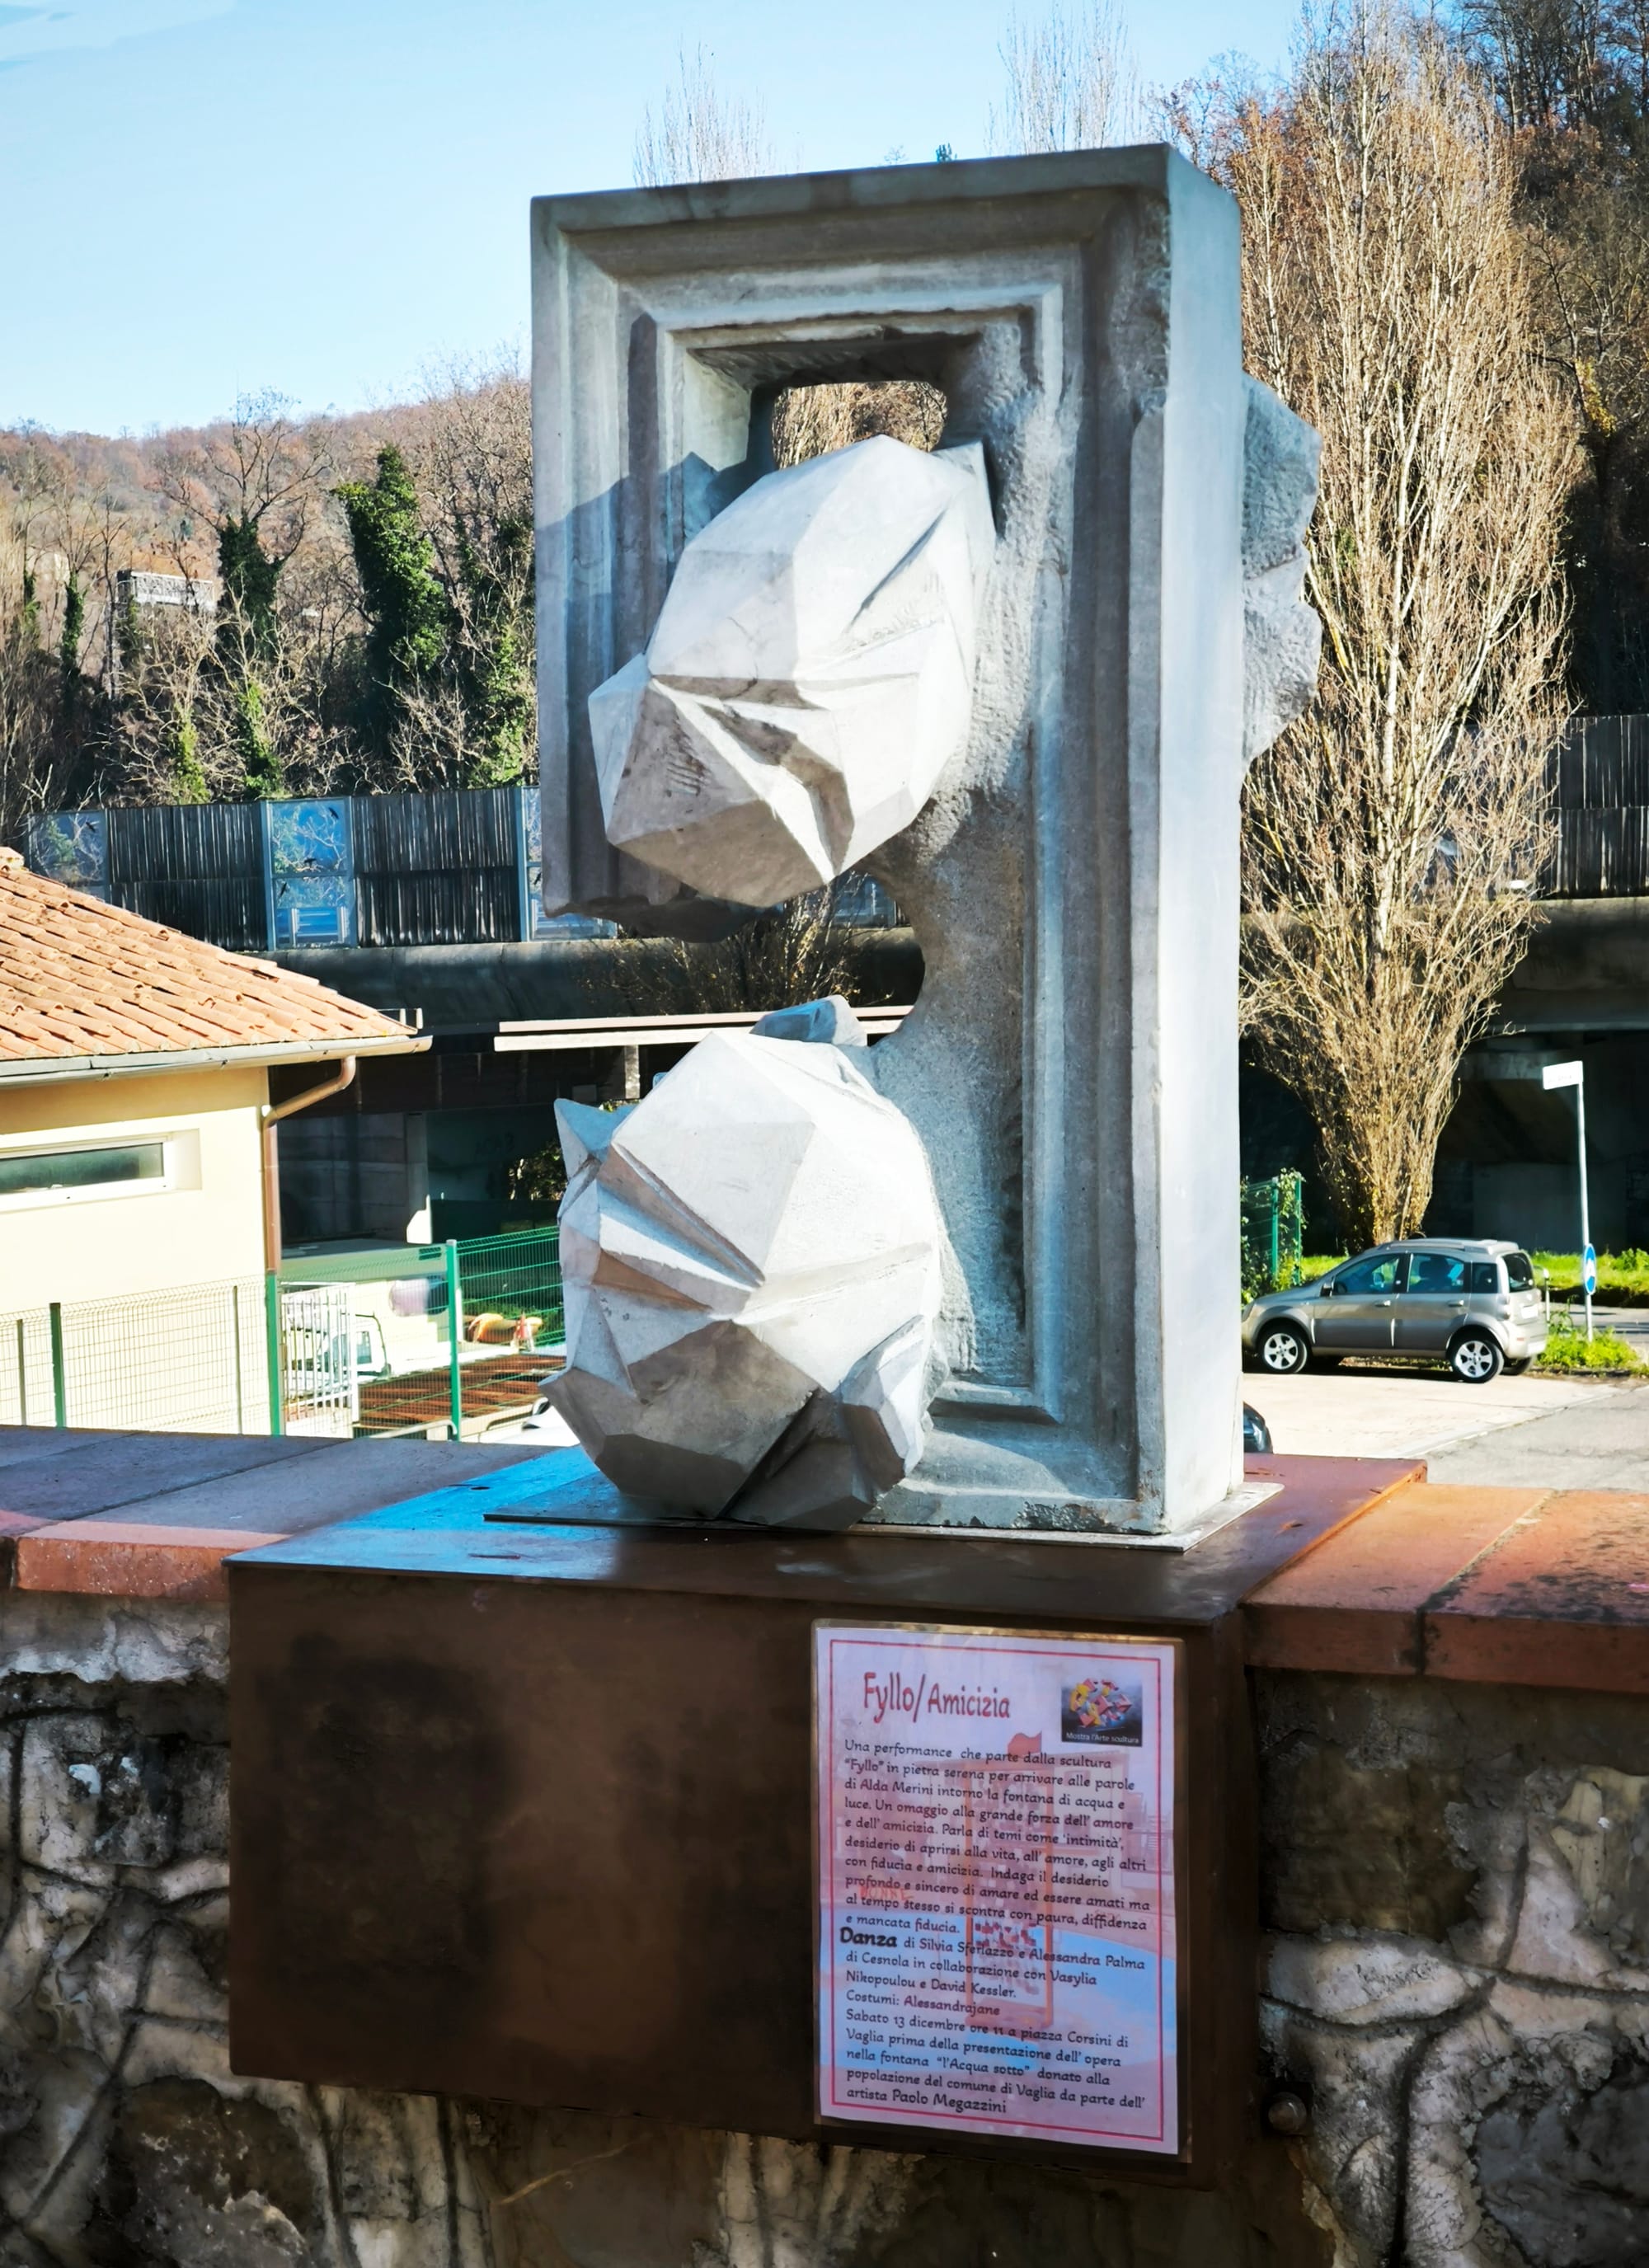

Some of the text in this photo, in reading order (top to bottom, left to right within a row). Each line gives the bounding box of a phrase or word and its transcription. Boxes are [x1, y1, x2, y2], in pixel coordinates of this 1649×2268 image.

[844, 1739, 1111, 1768] Una performance che parte dalla scultura
[886, 1761, 899, 1773] in
[902, 1763, 940, 1778] pietra
[944, 1768, 984, 1780] serena
[989, 1772, 1010, 1785] per
[1012, 1771, 1064, 1786] arrivare
[1067, 1773, 1091, 1787] alle
[1094, 1777, 1135, 1792] parole
[844, 1777, 1125, 1812] di Alda Merini intorno la fontana di acqua e
[844, 1796, 871, 1810] luce.
[875, 1798, 892, 1811] Un
[896, 1803, 948, 1819] omaggio
[951, 1804, 975, 1818] alla
[980, 1809, 1023, 1823] grande
[1027, 1810, 1060, 1826] forza
[1092, 1819, 1134, 1830] amore
[844, 1819, 852, 1827] e
[882, 1820, 938, 1834] amicizia.
[942, 1823, 973, 1838] Parla
[977, 1825, 989, 1838] di
[994, 1828, 1022, 1841] temi
[1025, 1834, 1059, 1844] come
[844, 1834, 900, 1850] desiderio
[904, 1839, 915, 1852] di
[919, 1843, 960, 1858] aprirsi
[964, 1845, 988, 1858] alla
[991, 1847, 1020, 1862] vita,
[1045, 1855, 1088, 1868] amore,
[1091, 1855, 1114, 1872] agli
[1119, 1857, 1147, 1871] altri
[844, 1856, 1109, 1888] con fiducia e amicizia. Indaga il desiderio
[845, 1874, 900, 1894] profondo
[904, 1882, 911, 1890] e
[914, 1880, 959, 1895] sincero
[962, 1883, 975, 1895] di
[979, 1889, 1019, 1899] amare
[1023, 1889, 1039, 1901] ed
[1043, 1894, 1082, 1905] essere
[1086, 1896, 1125, 1909] amati
[1128, 1901, 1150, 1911] ma
[845, 1892, 857, 1904] al
[861, 1896, 900, 1912] tempo
[904, 1897, 940, 1913] stesso
[945, 1901, 954, 1913] si
[959, 1906, 1005, 1918] scontra
[1009, 1910, 1033, 1920] con
[1036, 1913, 1078, 1928] paura,
[1081, 1912, 1147, 1930] diffidenza
[845, 1915, 960, 1933] e mancata fiducia.
[839, 1926, 898, 1948] Danza
[903, 1936, 915, 1949] di
[918, 1937, 953, 1952] Silvia
[1018, 1948, 1026, 1959] e
[1029, 1947, 1101, 1965] Alessandra
[1105, 1954, 1145, 1970] Palma
[845, 1950, 1097, 1988] di Cesnola in collaborazione con Vasylia
[846, 1969, 1016, 1998] Nikopoulou e David Kessler.
[846, 1989, 1000, 2017] Costumi: Alessandrajane
[846, 2007, 1128, 2048] Sabato 13 dicembre ore 11 a piazza Corsini di
[845, 2027, 884, 2045] Vaglia
[888, 2033, 925, 2048] prima
[928, 2036, 959, 2050] della
[962, 2043, 1051, 2060] presentazione
[1084, 2055, 1121, 2068] opera
[846, 2047, 876, 2061] nella
[880, 2050, 929, 2067] fontana
[1036, 2066, 1082, 2083] donato
[1085, 2072, 1110, 2086] alla
[846, 2068, 920, 2085] popolazione
[923, 2073, 942, 2087] del
[947, 2080, 996, 2092] comune
[999, 2082, 1012, 2094] di
[1015, 2083, 1055, 2102] Vaglia
[1059, 2087, 1076, 2101] da
[1080, 2094, 1115, 2107] parte
[846, 2087, 1007, 2113] artista Paolo Megazzini
